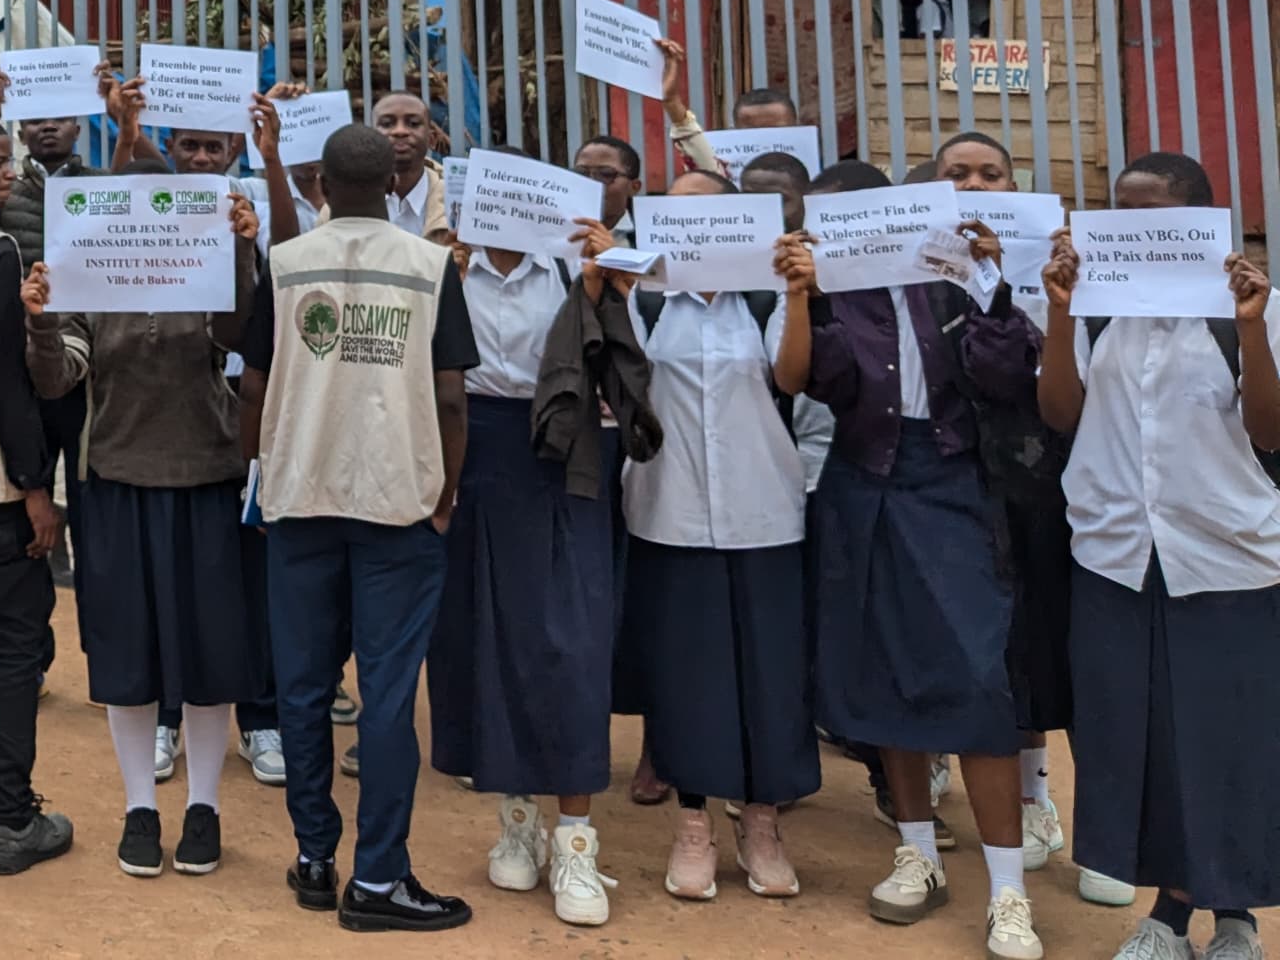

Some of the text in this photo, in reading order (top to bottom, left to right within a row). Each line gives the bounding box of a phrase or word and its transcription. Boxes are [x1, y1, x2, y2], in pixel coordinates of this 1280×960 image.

[8, 63, 17, 72] Je
[19, 63, 36, 71] suis
[38, 60, 68, 70] témoin
[151, 59, 197, 71] Ensemble
[199, 64, 223, 74] pour
[34, 74, 62, 83] contre
[64, 73, 72, 81] le
[151, 72, 222, 87] Éducation sans
[9, 88, 32, 97] VBG
[150, 87, 173, 98] VBG
[207, 92, 241, 103] Société
[162, 103, 184, 113] Paix
[300, 116, 331, 128] Contre
[734, 144, 760, 153] VBG
[482, 167, 539, 187] Tolérance
[541, 179, 569, 194] Zéro
[89, 190, 131, 204] COSAWOH
[175, 190, 217, 204] COSAWOH
[476, 184, 499, 197] face
[502, 191, 523, 201] aux
[474, 201, 566, 226] 100% Paix pour
[652, 212, 755, 228] Éduquer pour la
[820, 210, 869, 224] Respect
[884, 204, 905, 217] Fin
[909, 203, 931, 214] des
[959, 209, 1015, 220] cole sans
[107, 224, 180, 234] CLUB JEUNES
[472, 217, 500, 231] Tous
[822, 222, 929, 241] Violences Basées
[1087, 228, 1216, 243] Non aux VBG, Oui
[71, 237, 219, 248] AMBASSADEURS DE LA PAIX
[650, 233, 755, 245] Paix, Agir contre
[670, 251, 701, 262] VBG
[825, 243, 904, 259] sur le Genre
[1086, 250, 1205, 262] à la Paix dans nos
[85, 257, 203, 269] INSTITUT MUSAADA
[106, 275, 186, 285] Ville de Bukavu
[1087, 267, 1129, 282] Écoles
[342, 303, 411, 341] COSAWOH
[341, 336, 406, 350] COOPERATION TO
[359, 345, 373, 354] THE
[375, 347, 405, 359] WORLD
[340, 353, 404, 368] AND HUMANITY
